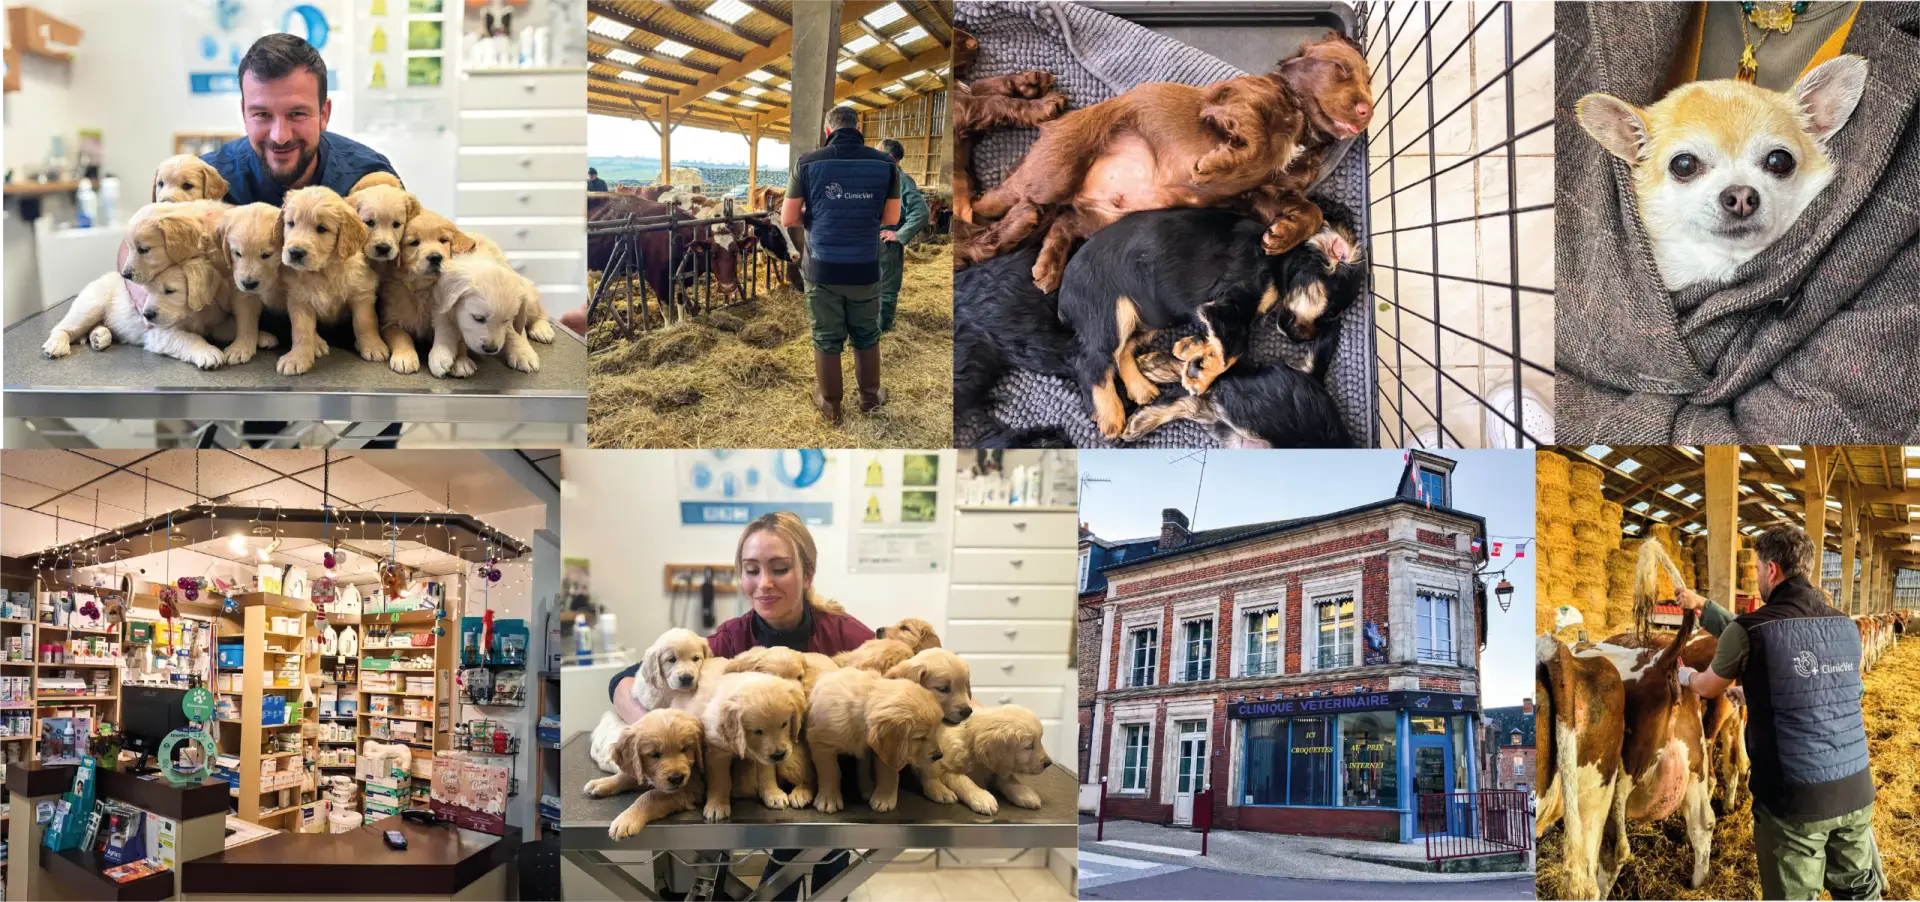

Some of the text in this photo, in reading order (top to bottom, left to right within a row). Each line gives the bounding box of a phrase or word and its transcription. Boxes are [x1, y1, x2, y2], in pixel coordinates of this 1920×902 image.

[1822, 662, 1853, 673] ClinicVet
[1239, 695, 1389, 715] CLINIQUE VETERINAIRE
